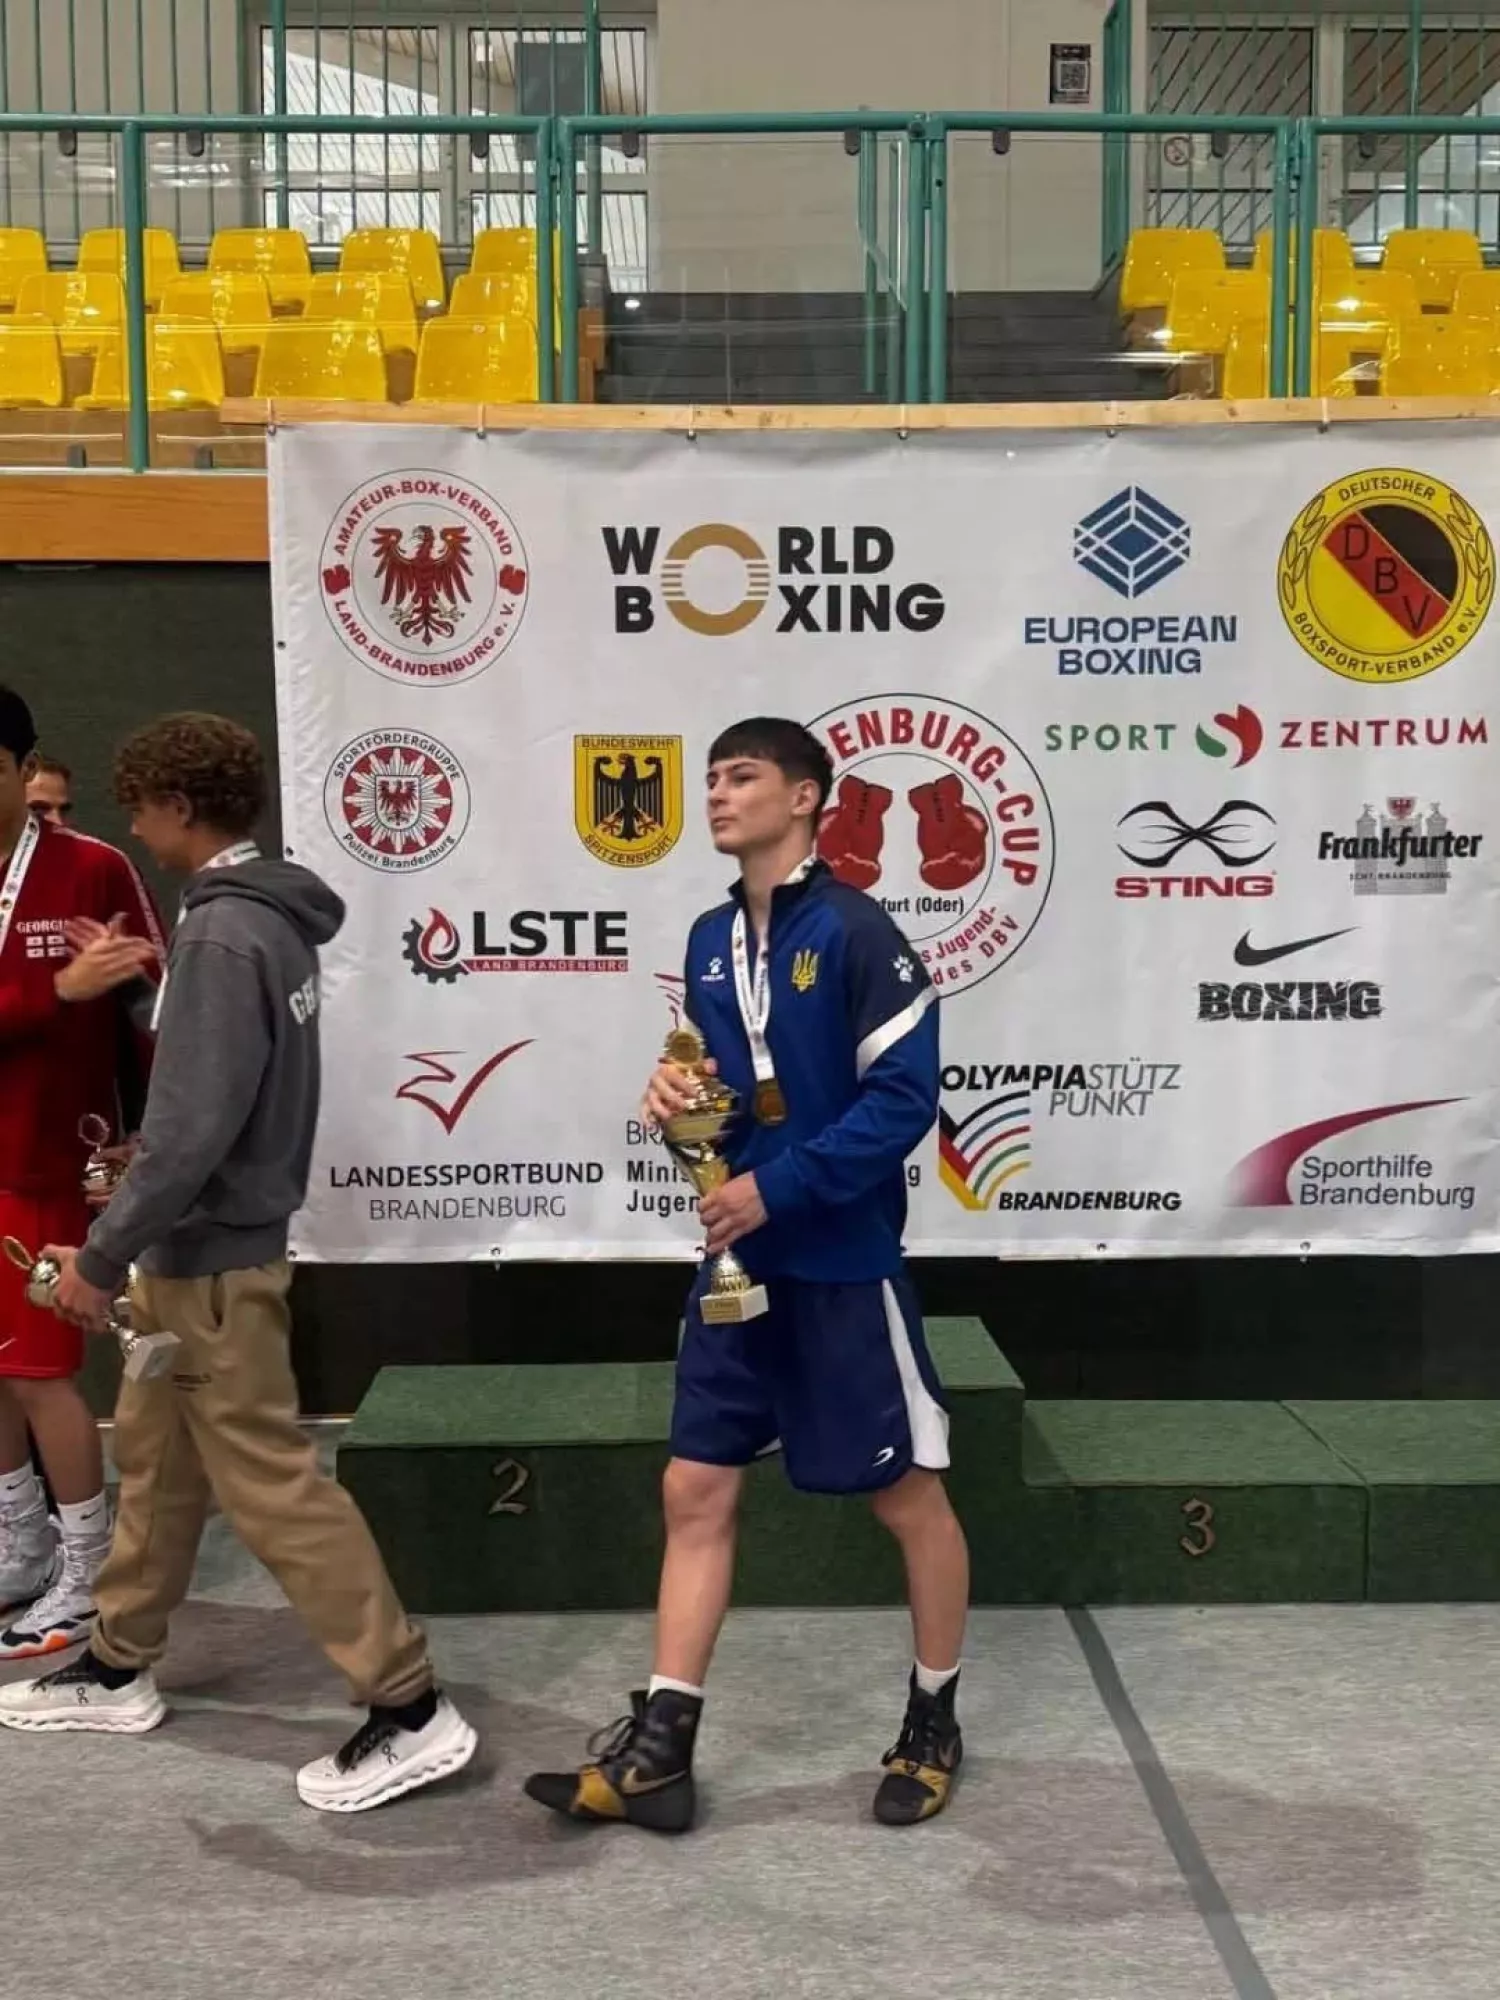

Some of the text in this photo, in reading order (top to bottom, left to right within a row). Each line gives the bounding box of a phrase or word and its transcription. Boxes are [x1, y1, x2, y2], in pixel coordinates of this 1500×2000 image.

[1339, 476, 1436, 501] DEUTSCHER
[334, 480, 512, 555] AMATEUR-BOX-VERBAND
[602, 525, 895, 576] WORLD
[614, 582, 946, 634] BOXING
[334, 600, 495, 677] LAND-BRANDENBURG
[1024, 615, 1238, 645] EUROPEAN
[1293, 612, 1456, 675] BOXSPORT-VERBAND
[1058, 648, 1201, 676] BOXING
[582, 738, 674, 748] BUNDESWEHR
[1045, 717, 1488, 751] SPORT ZENTRUM
[334, 732, 460, 781] SPORTFÖRDERGRUPPE
[823, 708, 1040, 886] ENBURG-CUP
[343, 833, 456, 868] Polizei Brandenburg
[585, 834, 673, 864] SPITZENSPORT
[1318, 826, 1483, 867] Frankfurter
[1114, 873, 1274, 899] STING
[916, 896, 965, 915] (Oder)
[472, 910, 629, 957] LSTE
[936, 906, 997, 959] Jugend-
[472, 960, 628, 972] LAND BRANDENBURG
[932, 914, 1020, 986] des DBV
[1197, 980, 1384, 1022] BOXING
[939, 1057, 1183, 1091] OLYMPIASTÜTZ
[1049, 1090, 1154, 1117] PUNKT
[330, 1162, 604, 1189] LANDESSPORTBUND
[1301, 1154, 1433, 1183] Sporthilfe
[370, 1196, 566, 1221] BRANDENBURG
[999, 1191, 1182, 1211] BRANDENBURG
[1301, 1182, 1475, 1210] Brandenburg
[489, 1458, 529, 1515] 2
[1180, 1498, 1216, 1556] 3
